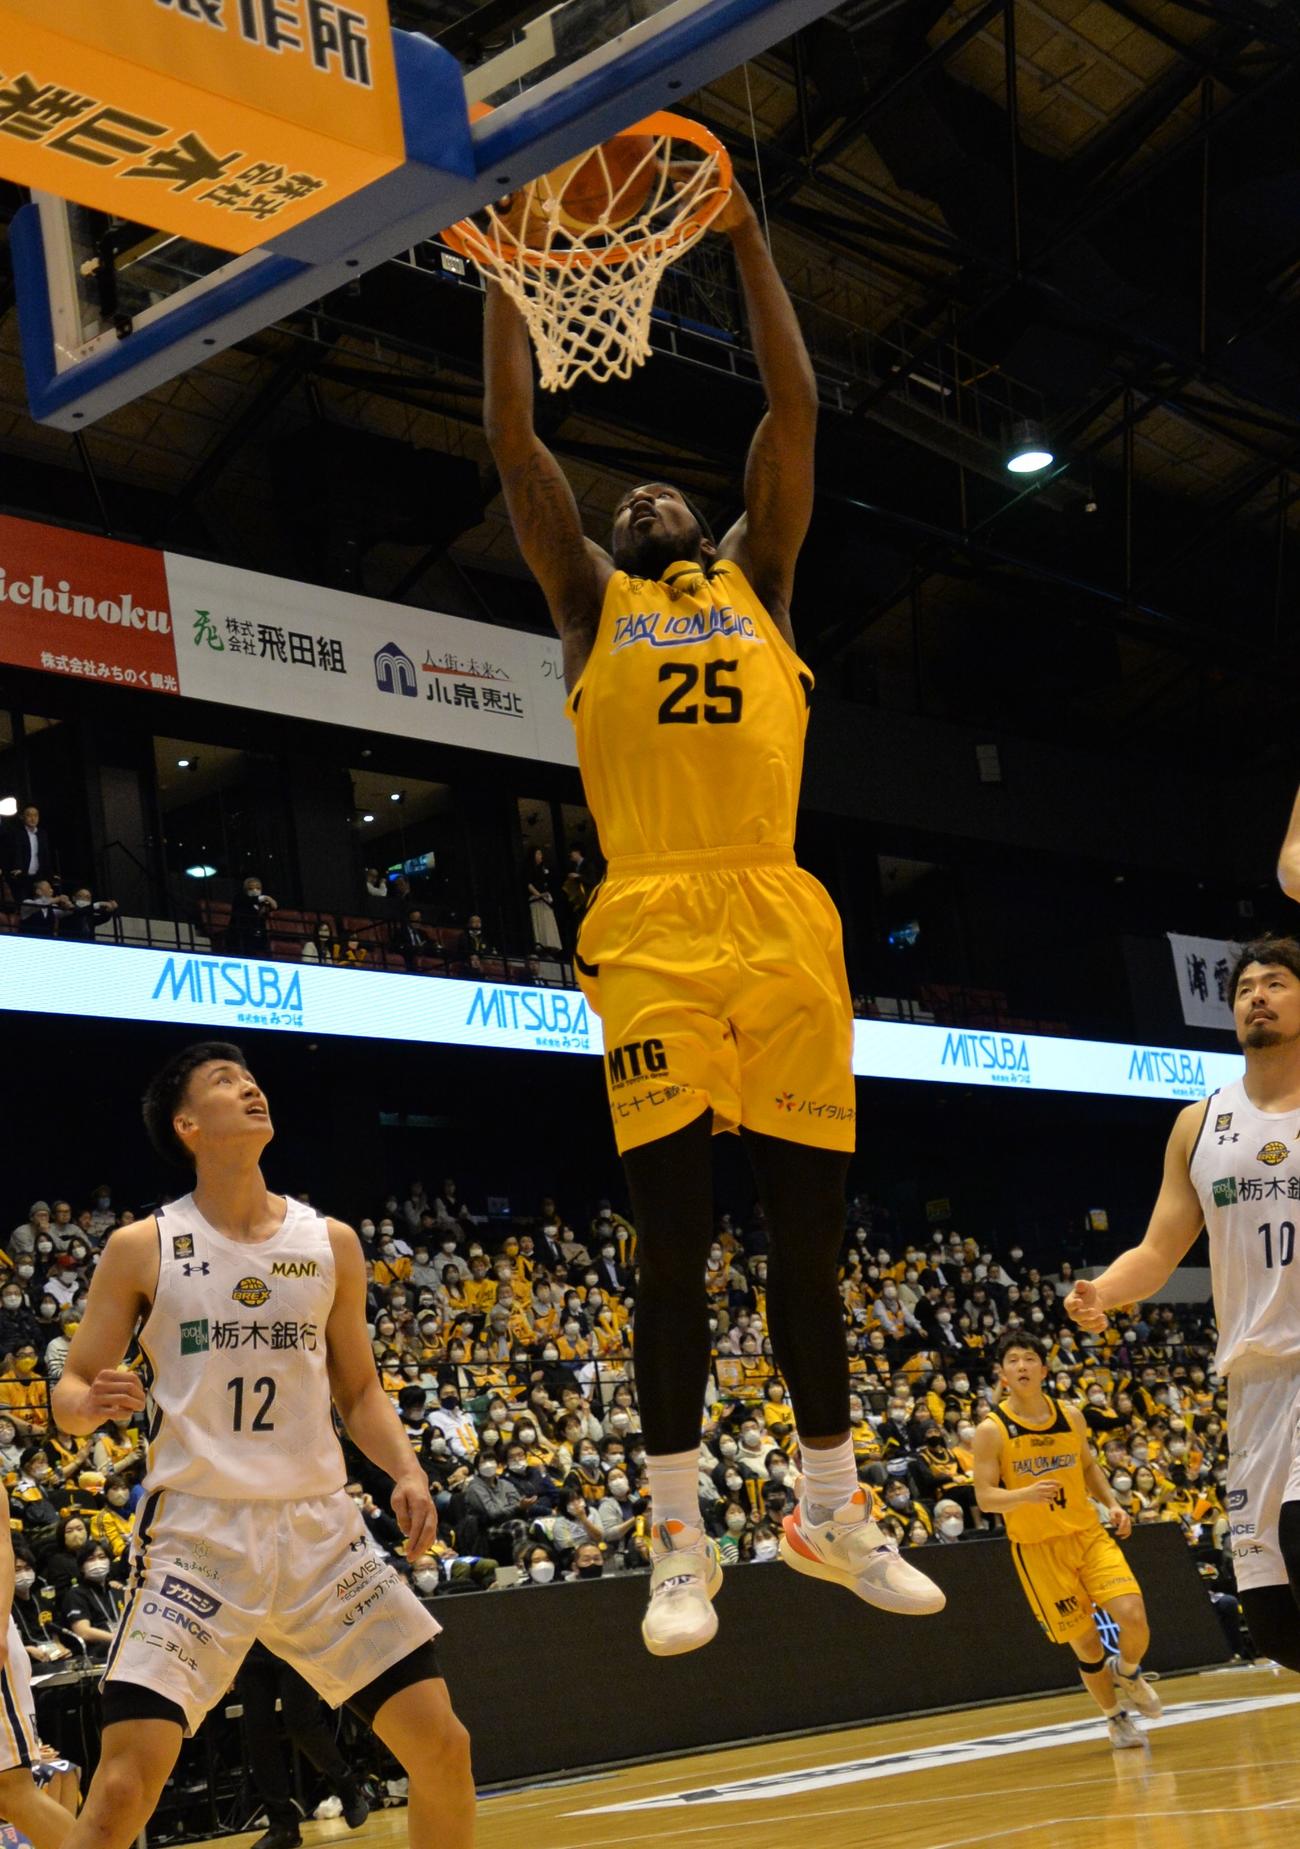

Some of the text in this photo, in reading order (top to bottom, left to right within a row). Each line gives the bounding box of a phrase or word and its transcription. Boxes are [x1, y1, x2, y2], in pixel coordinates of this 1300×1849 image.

[658, 659, 743, 725] 25
[152, 957, 303, 1011] MITSUBA
[465, 986, 589, 1034] MITSUBA
[608, 1038, 668, 1084] MTG
[941, 1032, 1030, 1072] MITSUBA
[1128, 1050, 1206, 1086] MITSUBA
[1258, 1221, 1296, 1269] 10
[270, 1260, 318, 1278] MANI
[232, 1289, 272, 1301] BREX
[211, 1321, 318, 1351] 栃木銀行
[226, 1376, 277, 1432] 12
[336, 1557, 381, 1597] ALMEX
[165, 1583, 214, 1613] ナカニシ
